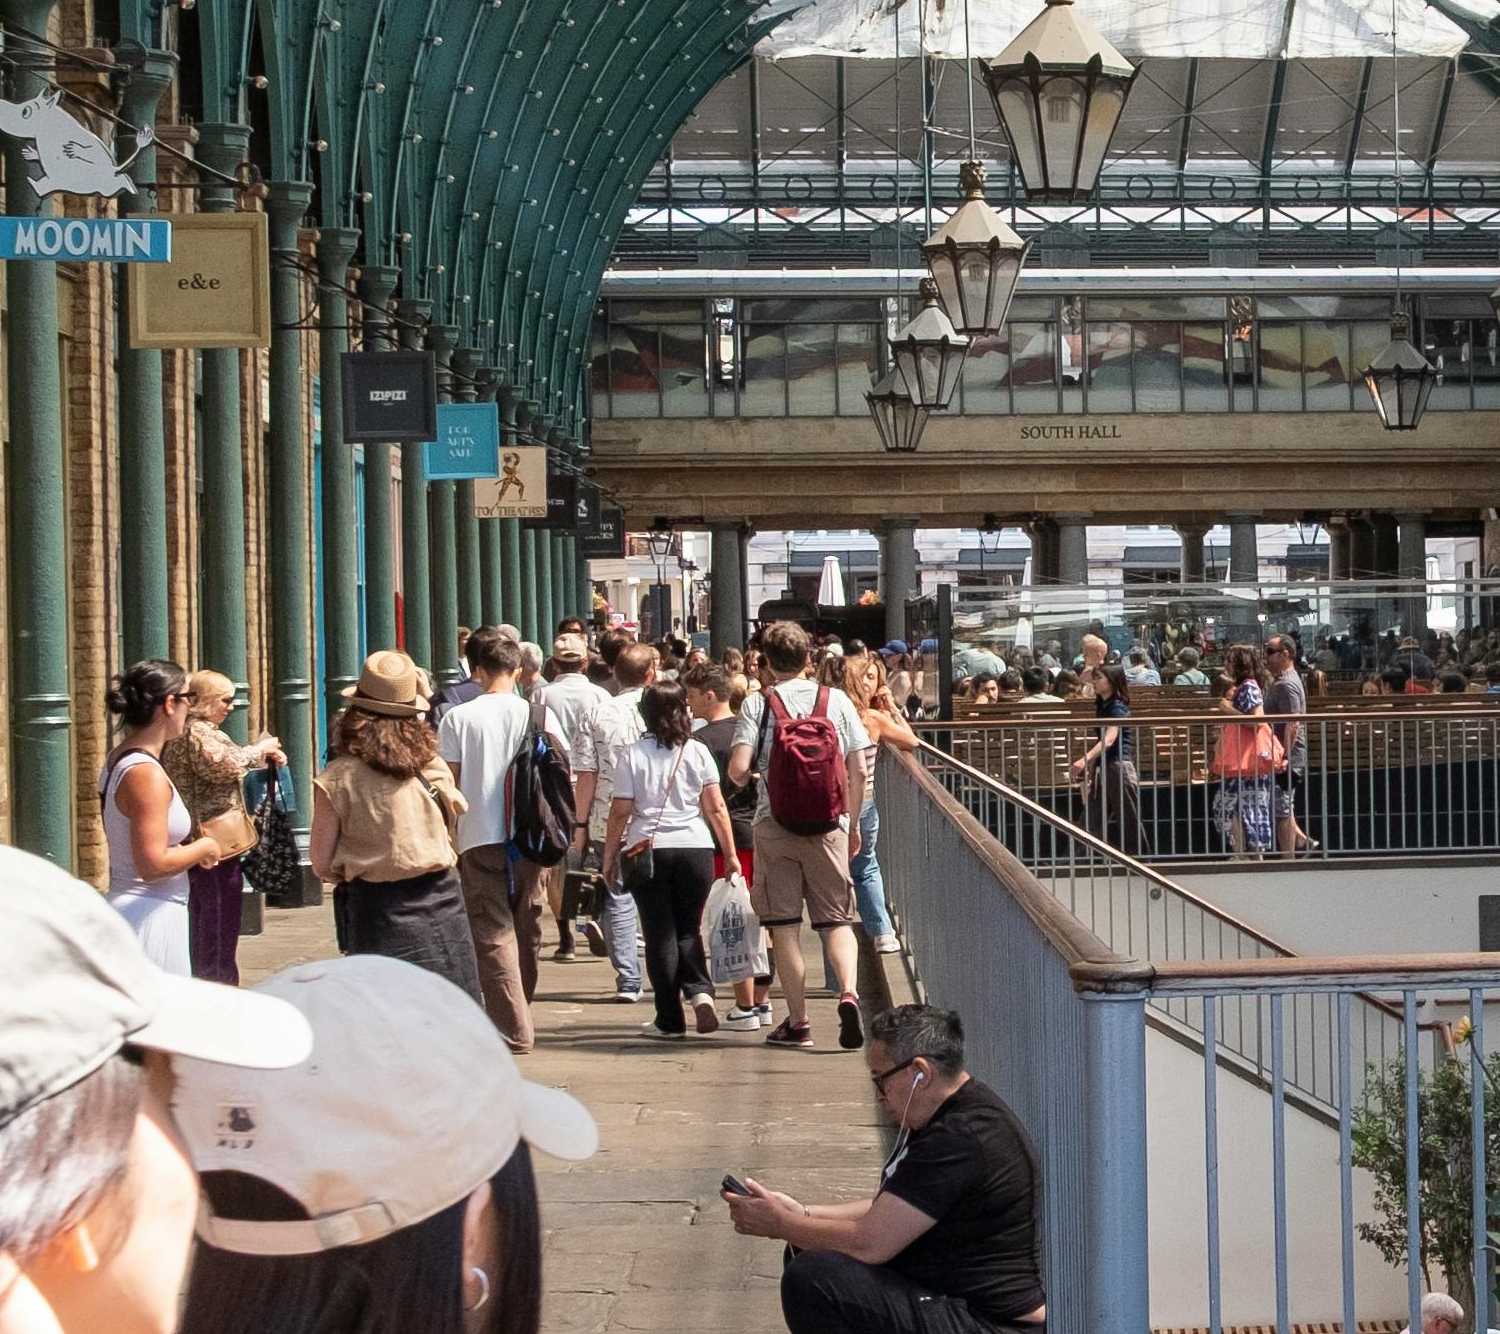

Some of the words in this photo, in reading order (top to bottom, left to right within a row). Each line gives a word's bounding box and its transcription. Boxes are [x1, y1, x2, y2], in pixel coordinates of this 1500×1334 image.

[14, 219, 151, 258] MOOMIN
[178, 273, 221, 290] e&e
[1020, 426, 1075, 440] SOUTH
[1078, 425, 1122, 439] HALL
